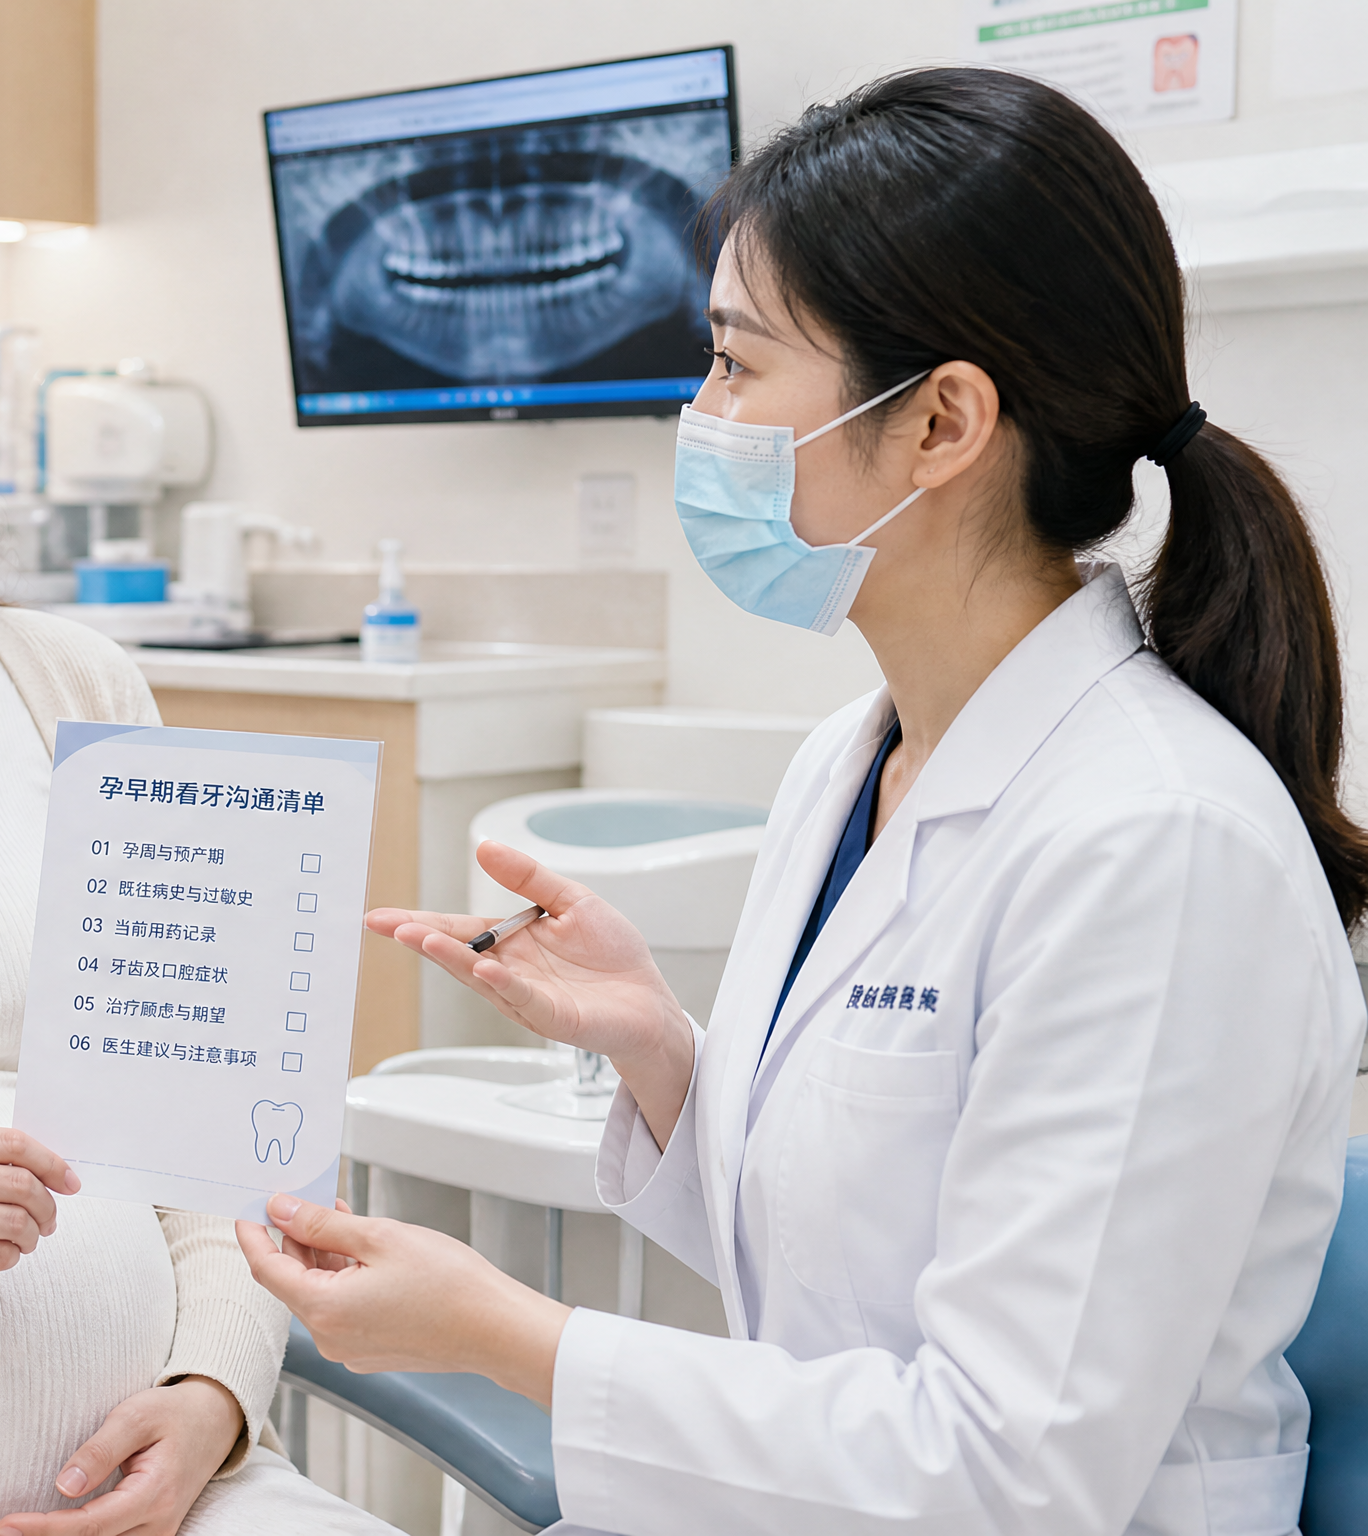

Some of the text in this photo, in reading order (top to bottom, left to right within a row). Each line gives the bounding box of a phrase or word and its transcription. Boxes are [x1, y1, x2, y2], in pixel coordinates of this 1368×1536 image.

[99, 775, 325, 816] 孕早期看牙沟通清单
[91, 839, 225, 866] 01 孕周与预产期
[86, 878, 253, 907] 02 既往病史与过敏史
[82, 916, 217, 943] 03 当前用药记录
[77, 956, 228, 984] 04 牙齿及口腔症状
[73, 994, 226, 1024] 05 治疗顾虑与期望
[69, 1034, 258, 1068] 06 医生建议与注意事项
